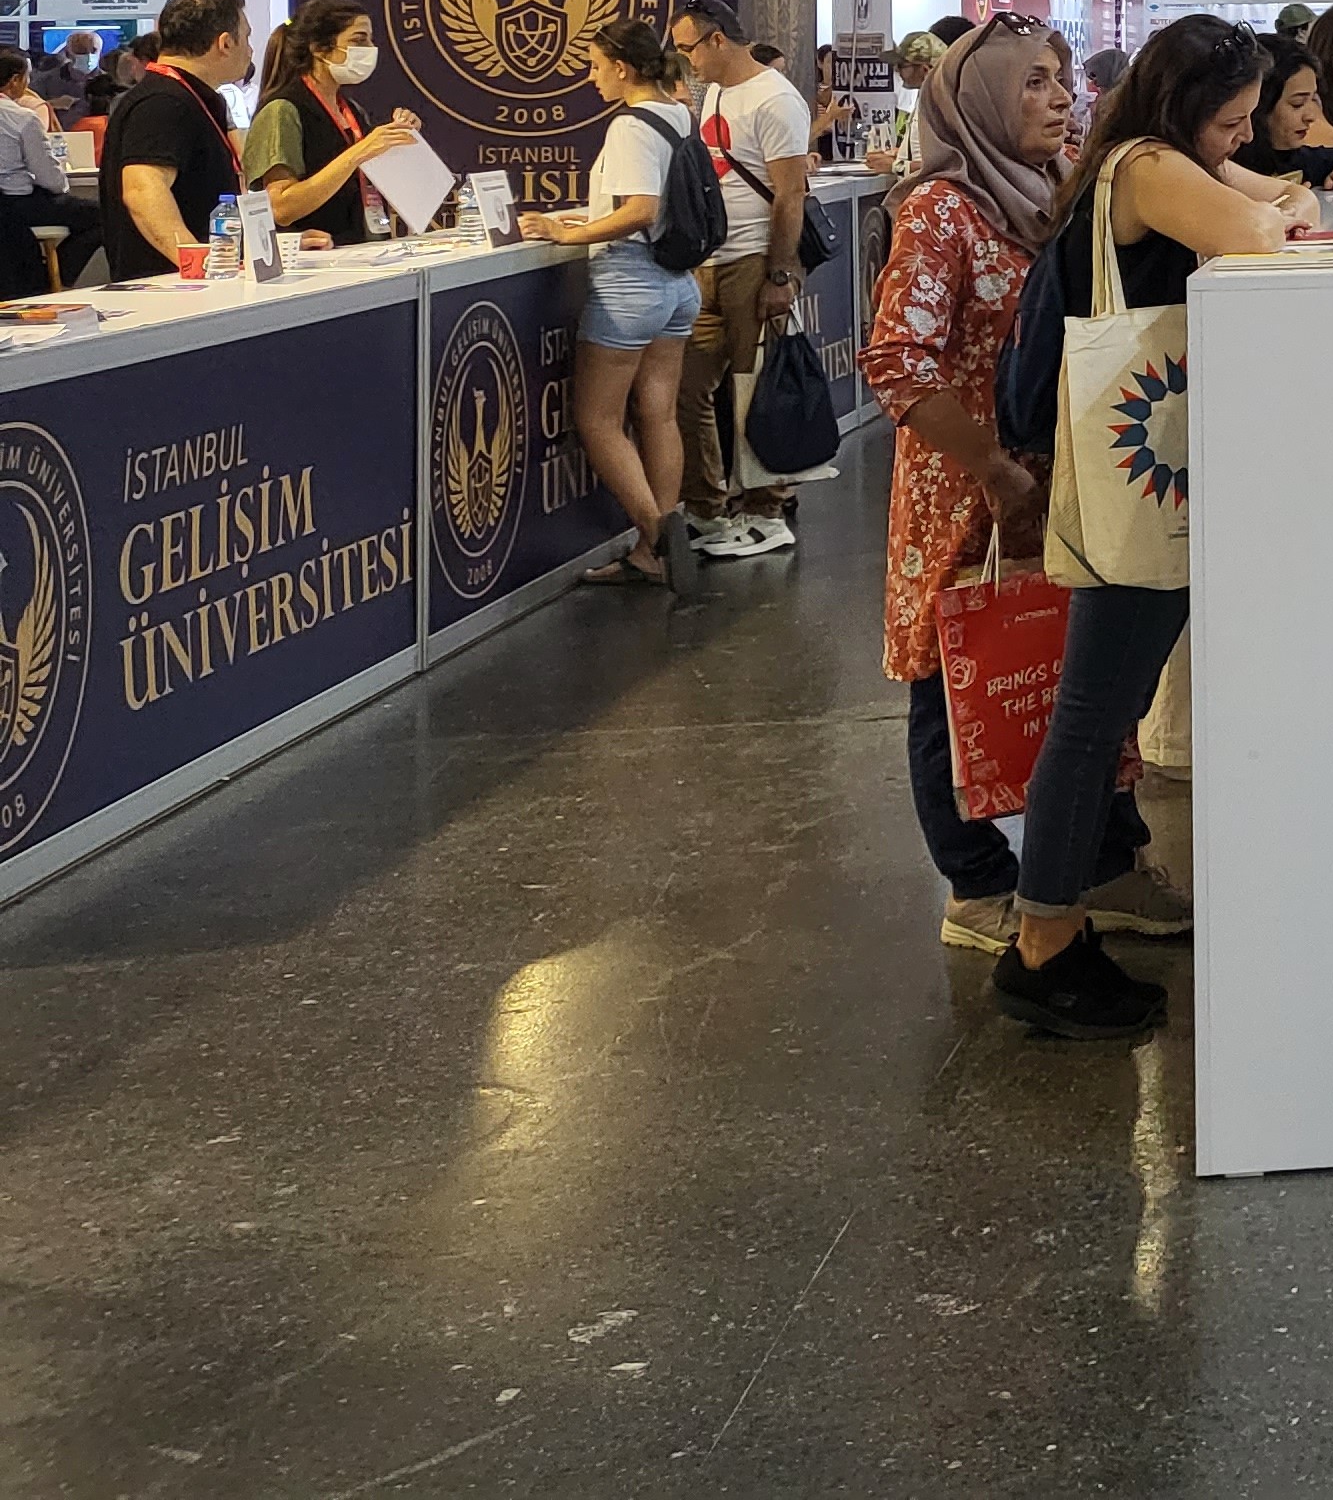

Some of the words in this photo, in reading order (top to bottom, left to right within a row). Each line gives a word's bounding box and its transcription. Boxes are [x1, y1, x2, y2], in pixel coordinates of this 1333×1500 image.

[494, 104, 567, 125] 2008
[477, 144, 582, 165] İSTANBUL
[122, 421, 249, 502] İSTANBUL
[117, 465, 316, 606] GELİŞİM
[117, 509, 414, 712] ÜNİVERSİTESİ
[986, 662, 1048, 698] BRINGS
[1001, 691, 1039, 720] THE
[1023, 717, 1040, 738] IN
